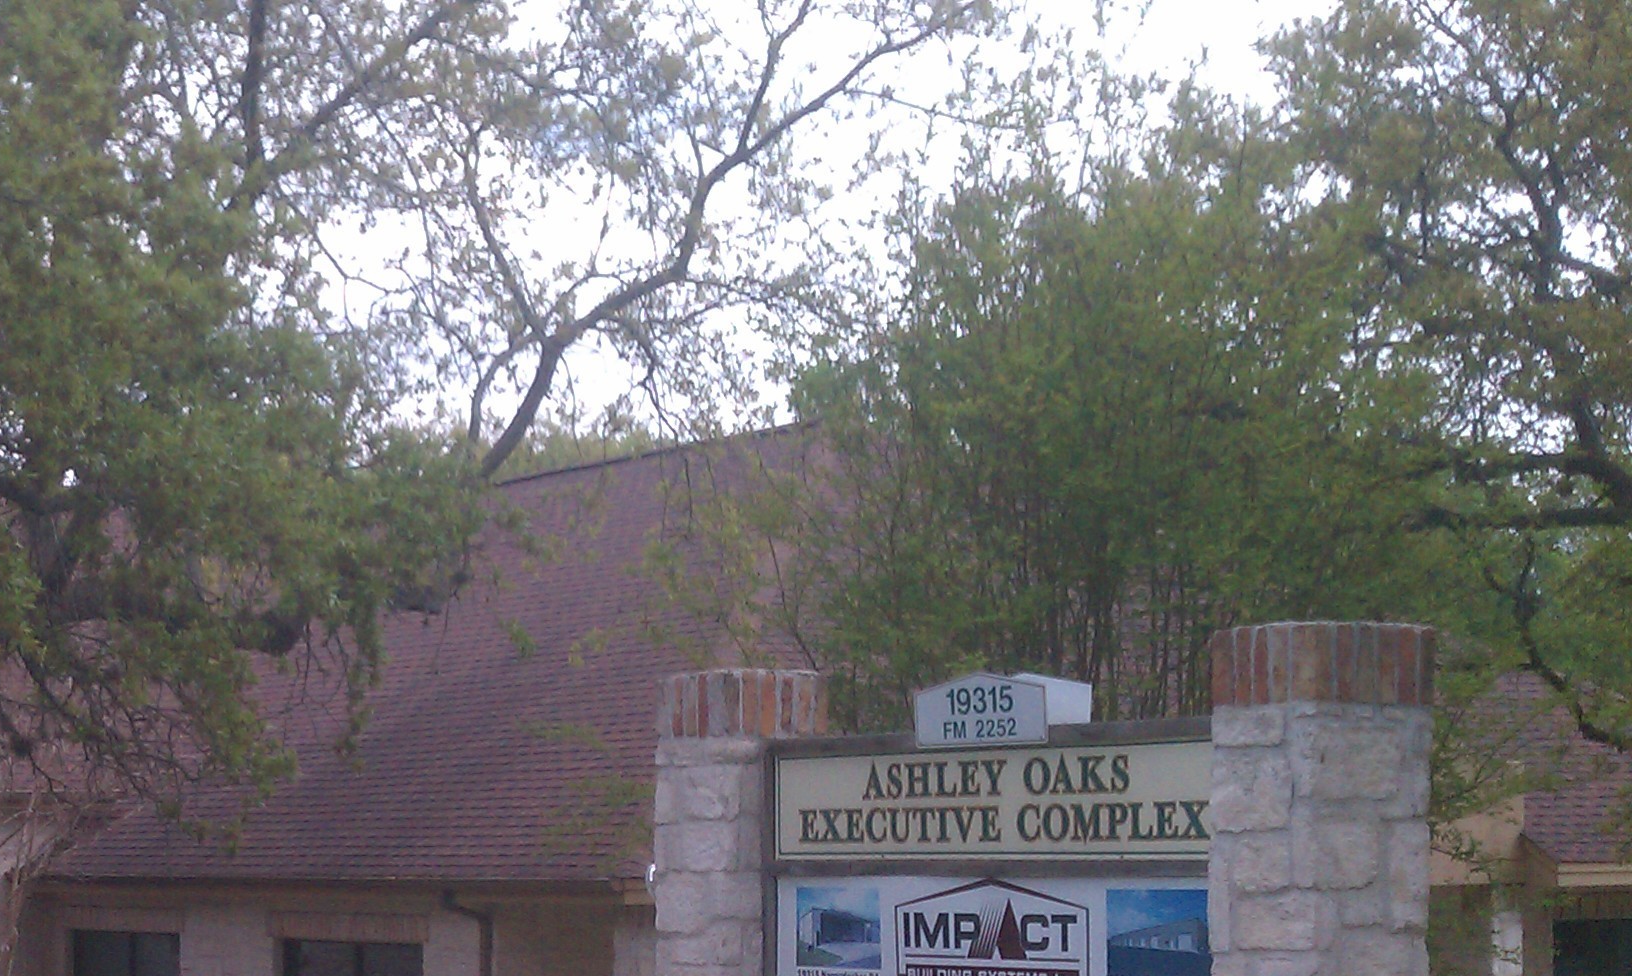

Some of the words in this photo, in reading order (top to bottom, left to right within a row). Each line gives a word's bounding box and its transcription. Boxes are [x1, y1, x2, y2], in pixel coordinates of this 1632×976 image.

[945, 685, 1014, 715] 19315
[943, 721, 967, 739] FM
[975, 718, 1017, 738] 2252
[862, 758, 1008, 800] ASHLEY
[1023, 753, 1130, 796] OAKS
[798, 804, 1002, 844] EXECUTIVE
[1016, 800, 1211, 843] COMPLEX
[903, 898, 1077, 960] IMPACT
